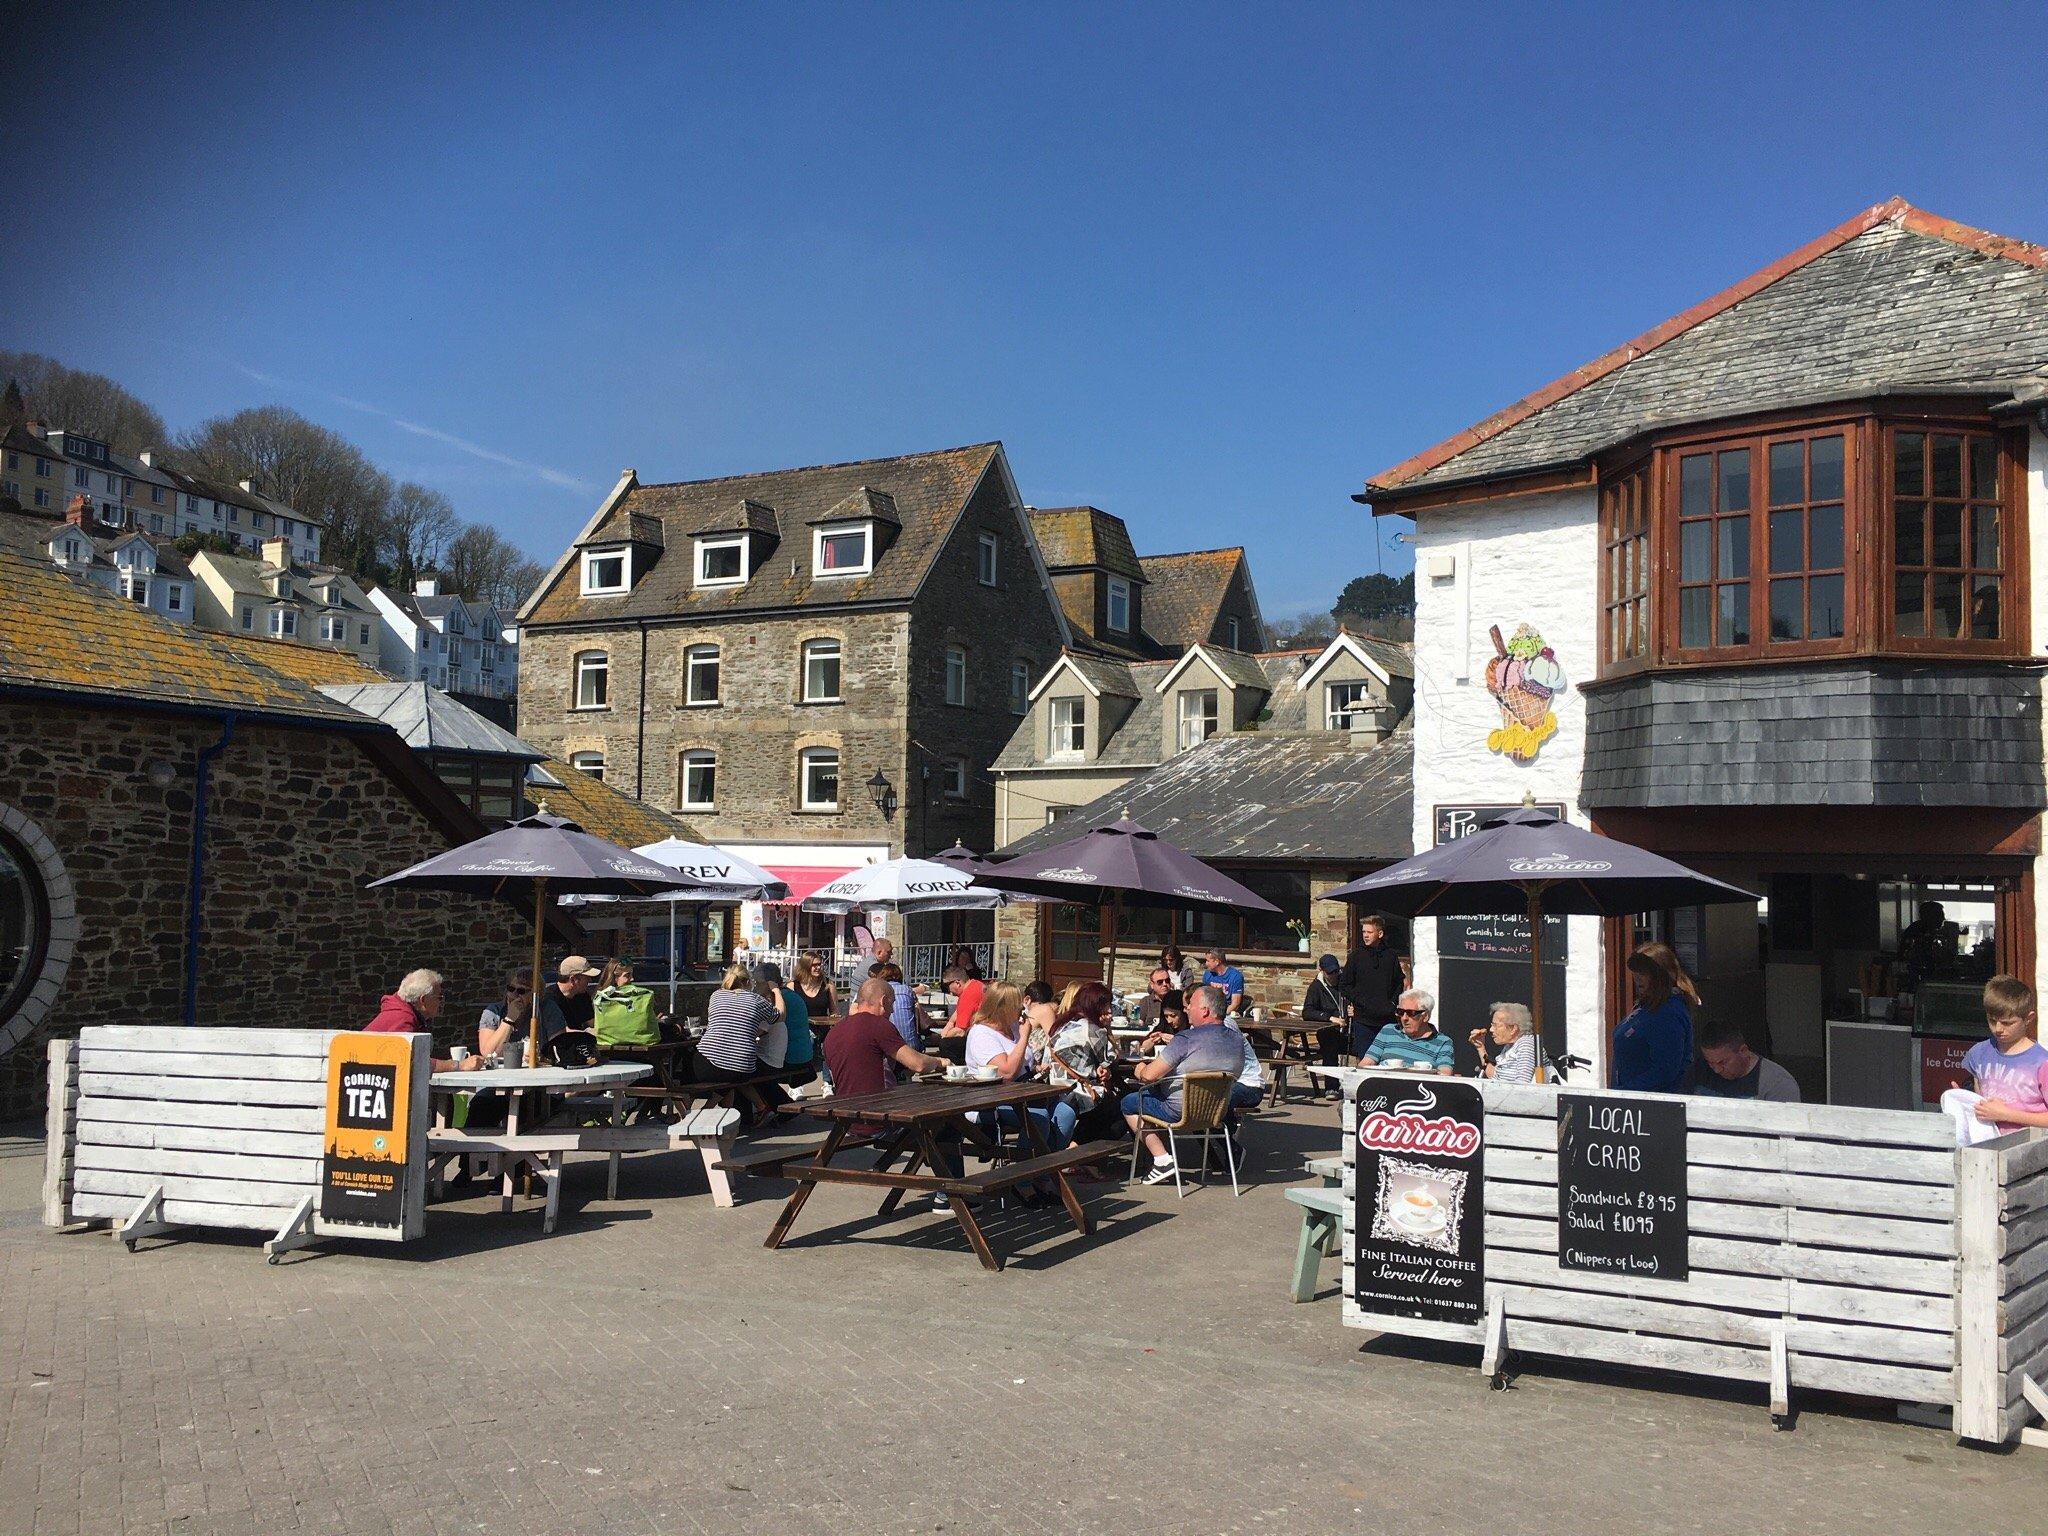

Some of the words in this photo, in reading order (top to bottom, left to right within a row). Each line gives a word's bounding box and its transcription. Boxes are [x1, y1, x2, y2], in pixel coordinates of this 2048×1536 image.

[1446, 810, 1479, 839] Pie
[674, 865, 731, 879] REV
[824, 882, 867, 895] KOREV
[905, 880, 971, 893] KOREV
[1513, 928, 1532, 938] Crea
[1947, 1047, 1967, 1057] Lux
[1926, 1058, 1941, 1068] Ice
[1943, 1058, 1964, 1070] Cre
[343, 1073, 390, 1090] CORNISH
[346, 1088, 387, 1119] TEA
[1588, 1104, 1651, 1136] LOCAL
[1362, 1117, 1479, 1151] Carraro
[1587, 1143, 1641, 1172] CRAB
[331, 1171, 352, 1180] YOU'LL
[352, 1172, 368, 1182] LOVE
[368, 1173, 382, 1183] OUR
[382, 1175, 394, 1184] TEA
[1569, 1185, 1632, 1206] Sandwich
[1567, 1210, 1605, 1231] Salad
[1361, 1249, 1386, 1261] FINE
[1389, 1251, 1432, 1266] ITALIAN
[1435, 1258, 1477, 1272] COFFEE
[1566, 1248, 1612, 1268] (Nippers
[1615, 1256, 1628, 1270] of
[1630, 1254, 1659, 1274] Looe)
[1372, 1263, 1430, 1284] Served
[1427, 1269, 1465, 1288] here
[1422, 1297, 1434, 1306] Tel:
[1434, 1299, 1453, 1308] 01637
[1466, 1302, 1478, 1310] 343
